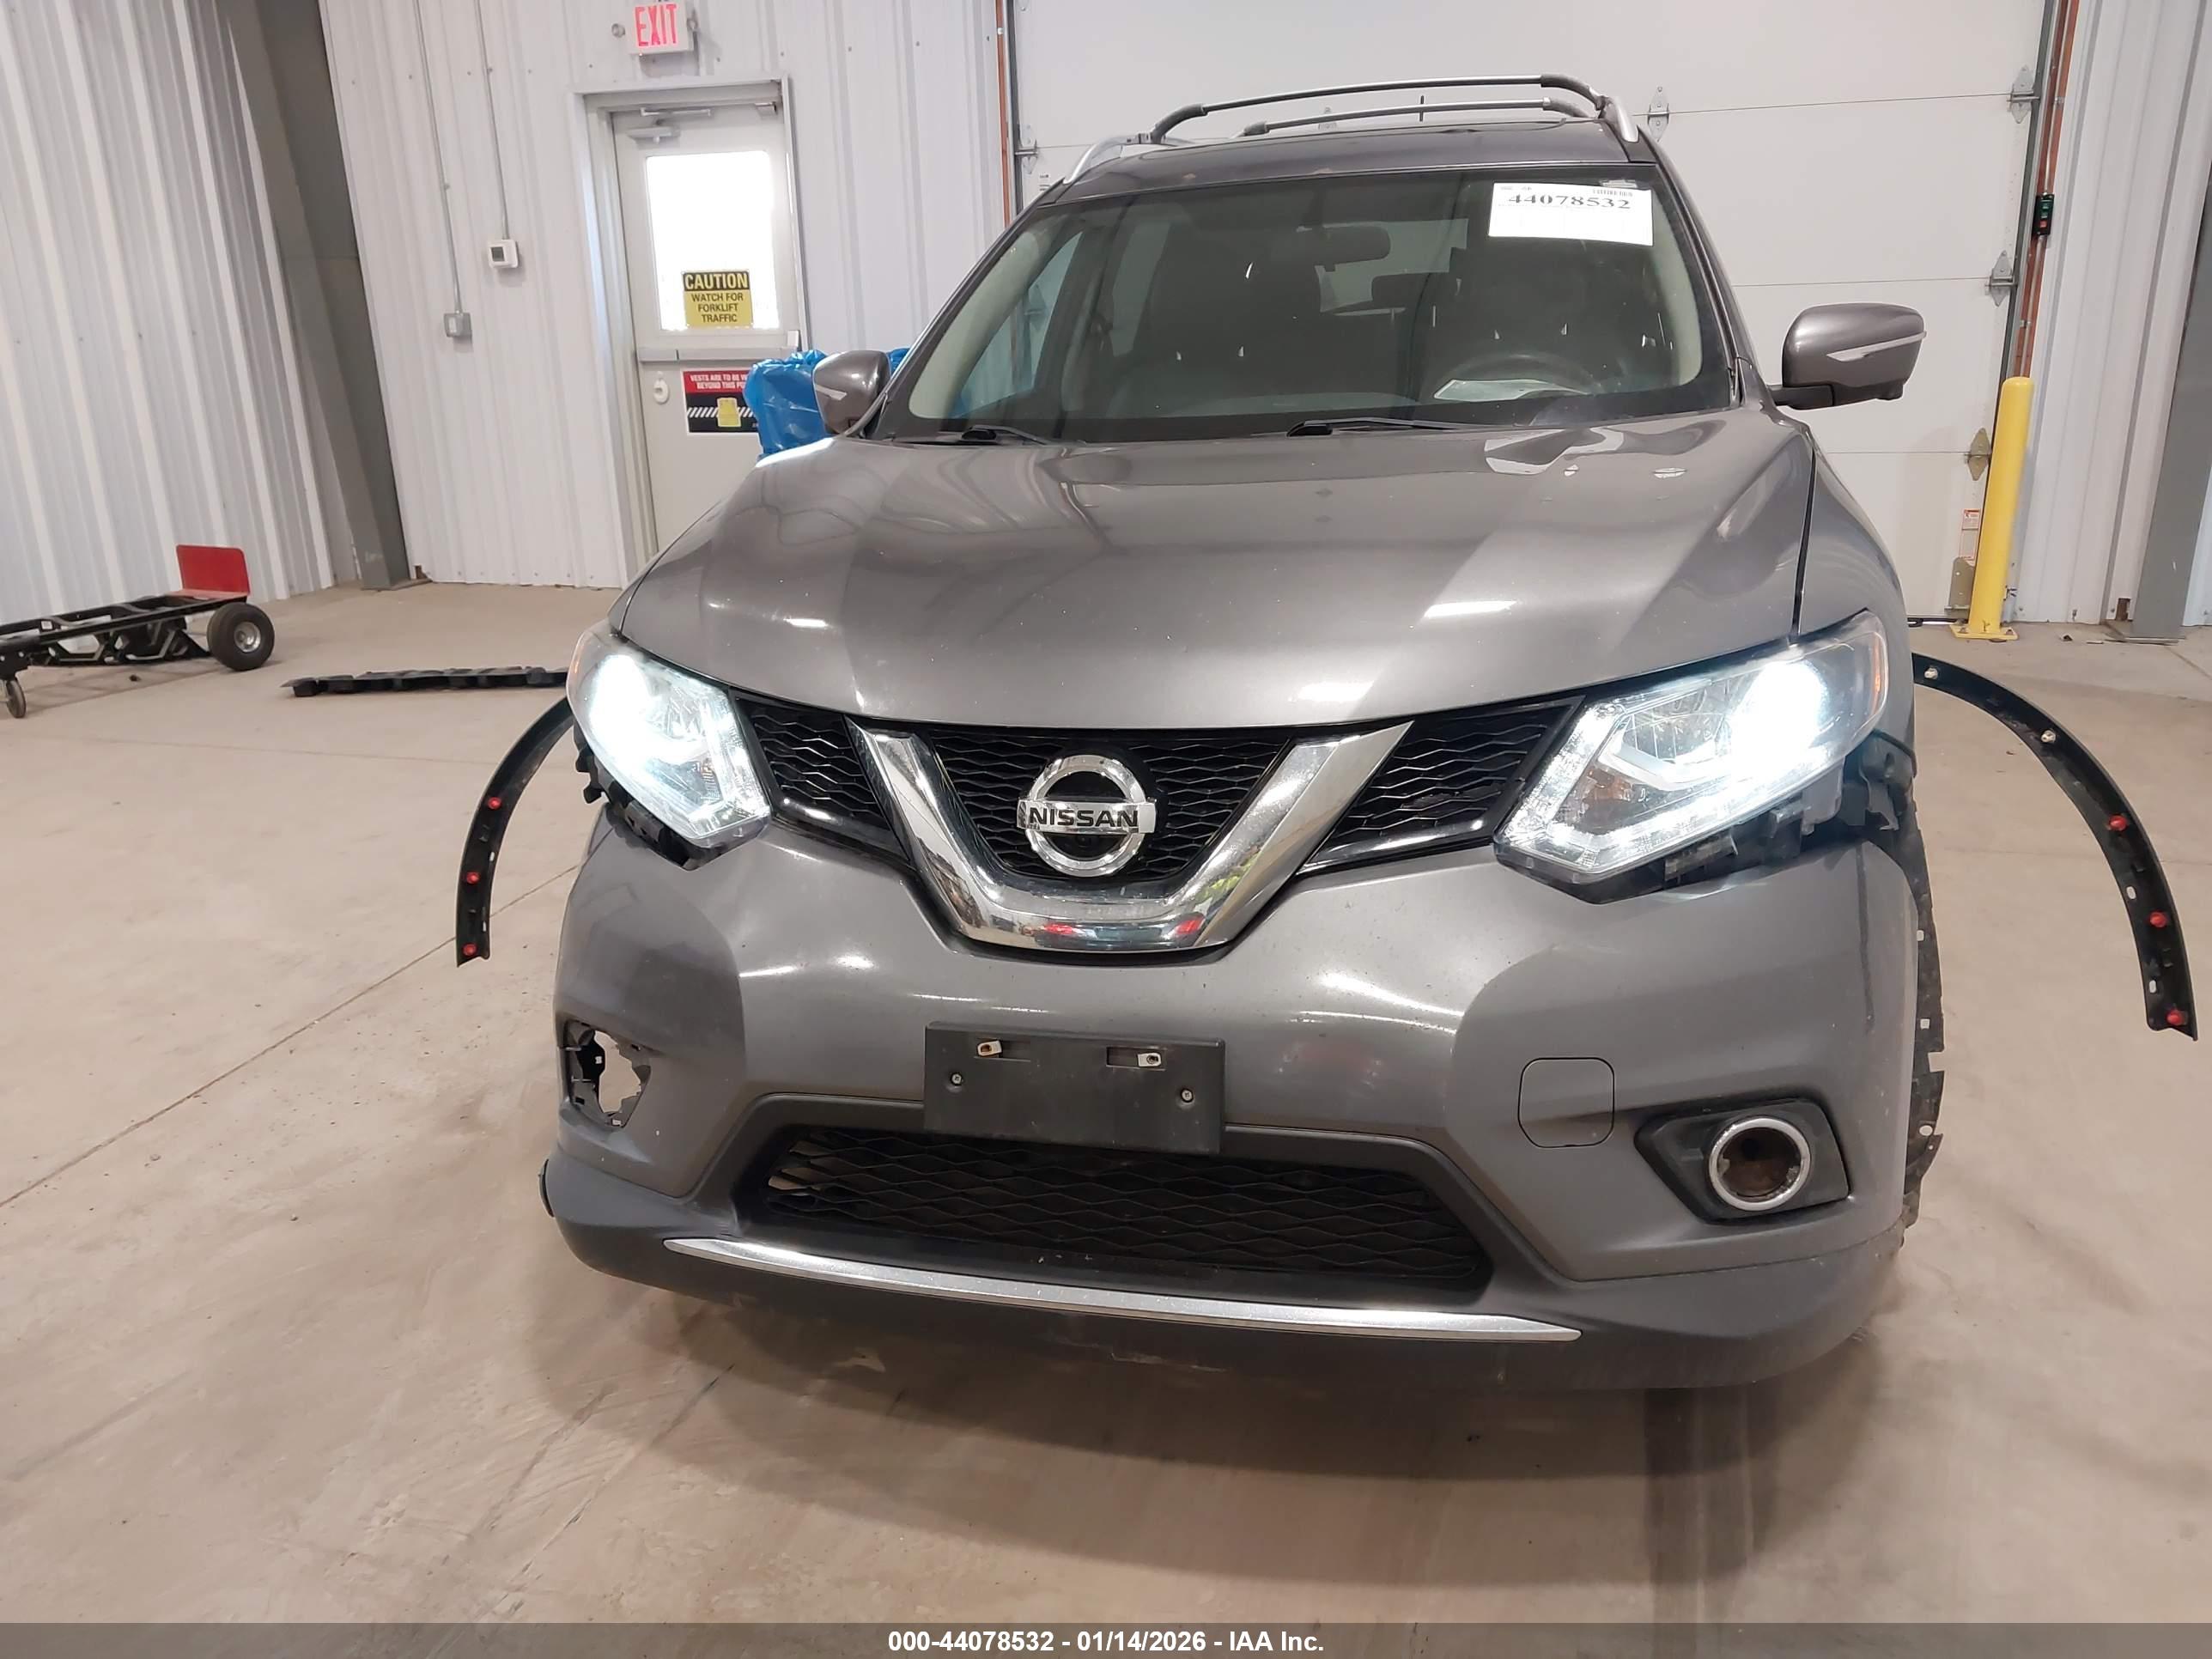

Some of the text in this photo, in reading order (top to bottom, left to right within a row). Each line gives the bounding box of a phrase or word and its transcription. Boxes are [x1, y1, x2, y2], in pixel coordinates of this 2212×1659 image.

[635, 4, 677, 46] EXIT
[1509, 194, 1631, 210] 44078532
[684, 273, 748, 289] CAUTION
[691, 292, 744, 302] WATCH FOR
[697, 303, 739, 313] FORKLIFT
[701, 313, 738, 323] TRAFFIC
[1030, 807, 1139, 827] NISSAN
